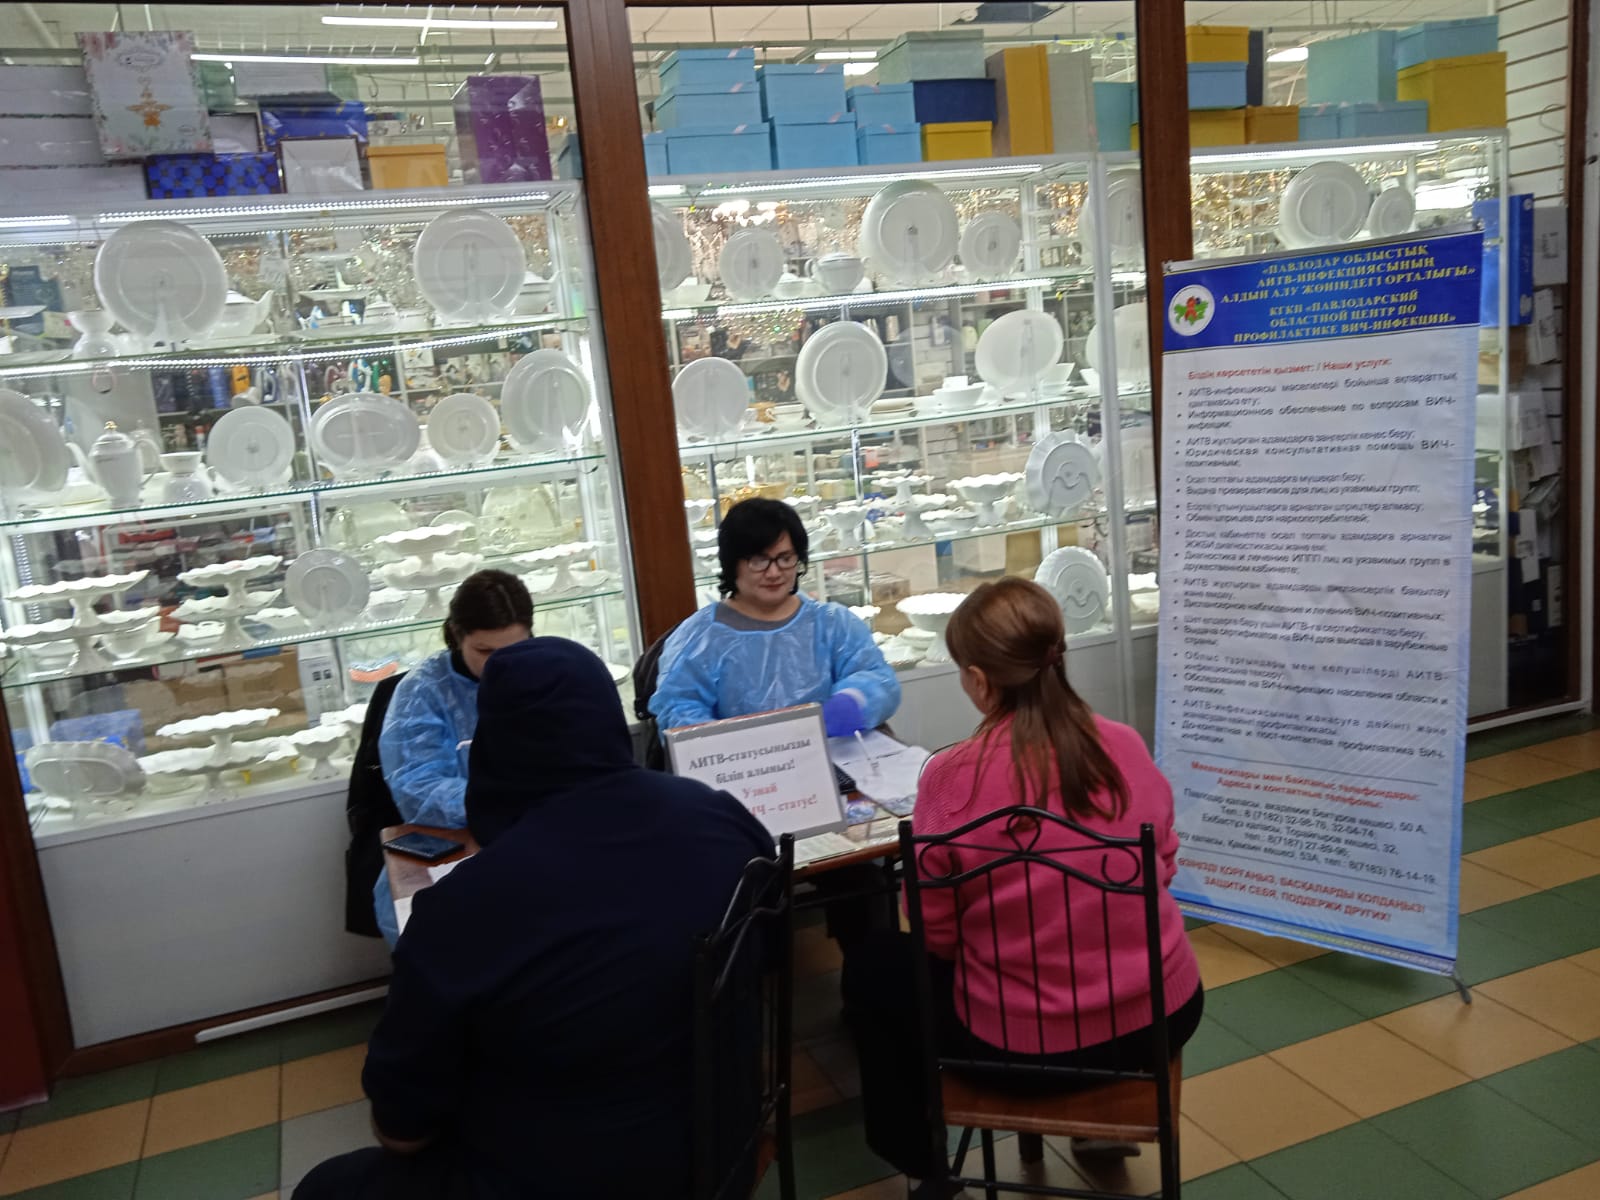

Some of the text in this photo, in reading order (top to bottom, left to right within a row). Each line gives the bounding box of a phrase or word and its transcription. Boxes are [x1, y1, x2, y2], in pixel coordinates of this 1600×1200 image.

[1221, 289, 1268, 304] АЛДЫН
[1271, 285, 1298, 297] АЛУ
[1269, 288, 1418, 315] КГКП «ПАВЛОДАРСКИЙ
[1270, 304, 1416, 327] ОБЛАСТНОЙ ЦЕНТР ПО
[1233, 312, 1456, 343] ПРОФИЛАКТИКЕ ВИЧ-ИНФЕКЦИИ»
[742, 783, 778, 799] Узнай
[778, 794, 817, 812] статус!
